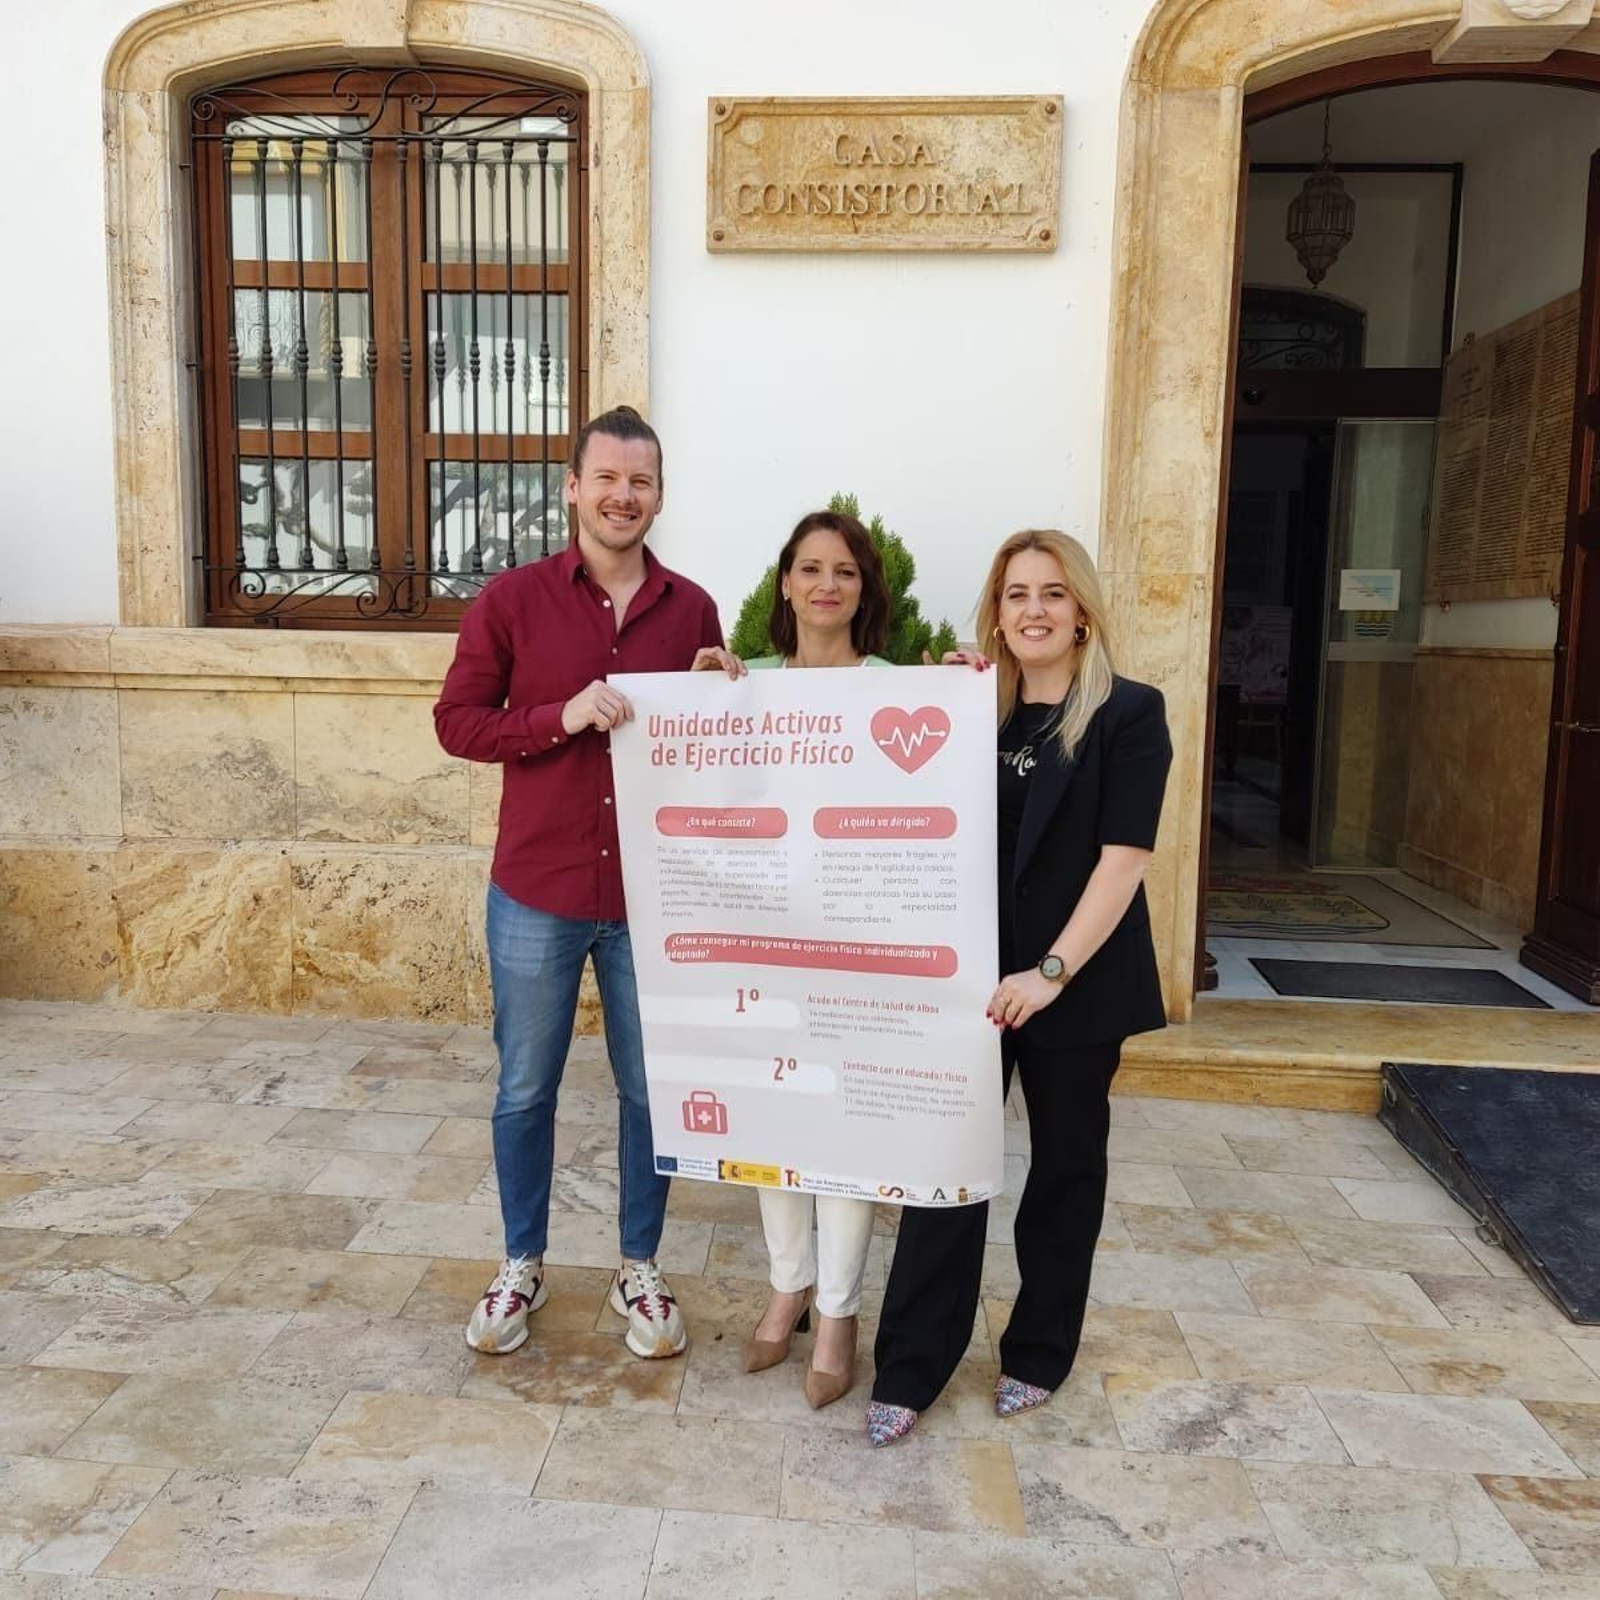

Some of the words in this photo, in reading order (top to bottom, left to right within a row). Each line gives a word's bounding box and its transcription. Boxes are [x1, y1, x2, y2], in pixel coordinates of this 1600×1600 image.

[831, 133, 939, 168] CASA
[736, 182, 1035, 217] CONSISTORIAL
[649, 711, 755, 738] Unidades
[760, 711, 843, 735] Activas
[651, 742, 677, 766] de
[685, 742, 782, 773] Ejercicio
[790, 737, 855, 765] Físico
[717, 816, 756, 829] consiste?
[850, 815, 876, 830] quién
[890, 815, 931, 830] dirigido?
[735, 988, 760, 1014] 1º
[773, 1056, 798, 1082] 2º
